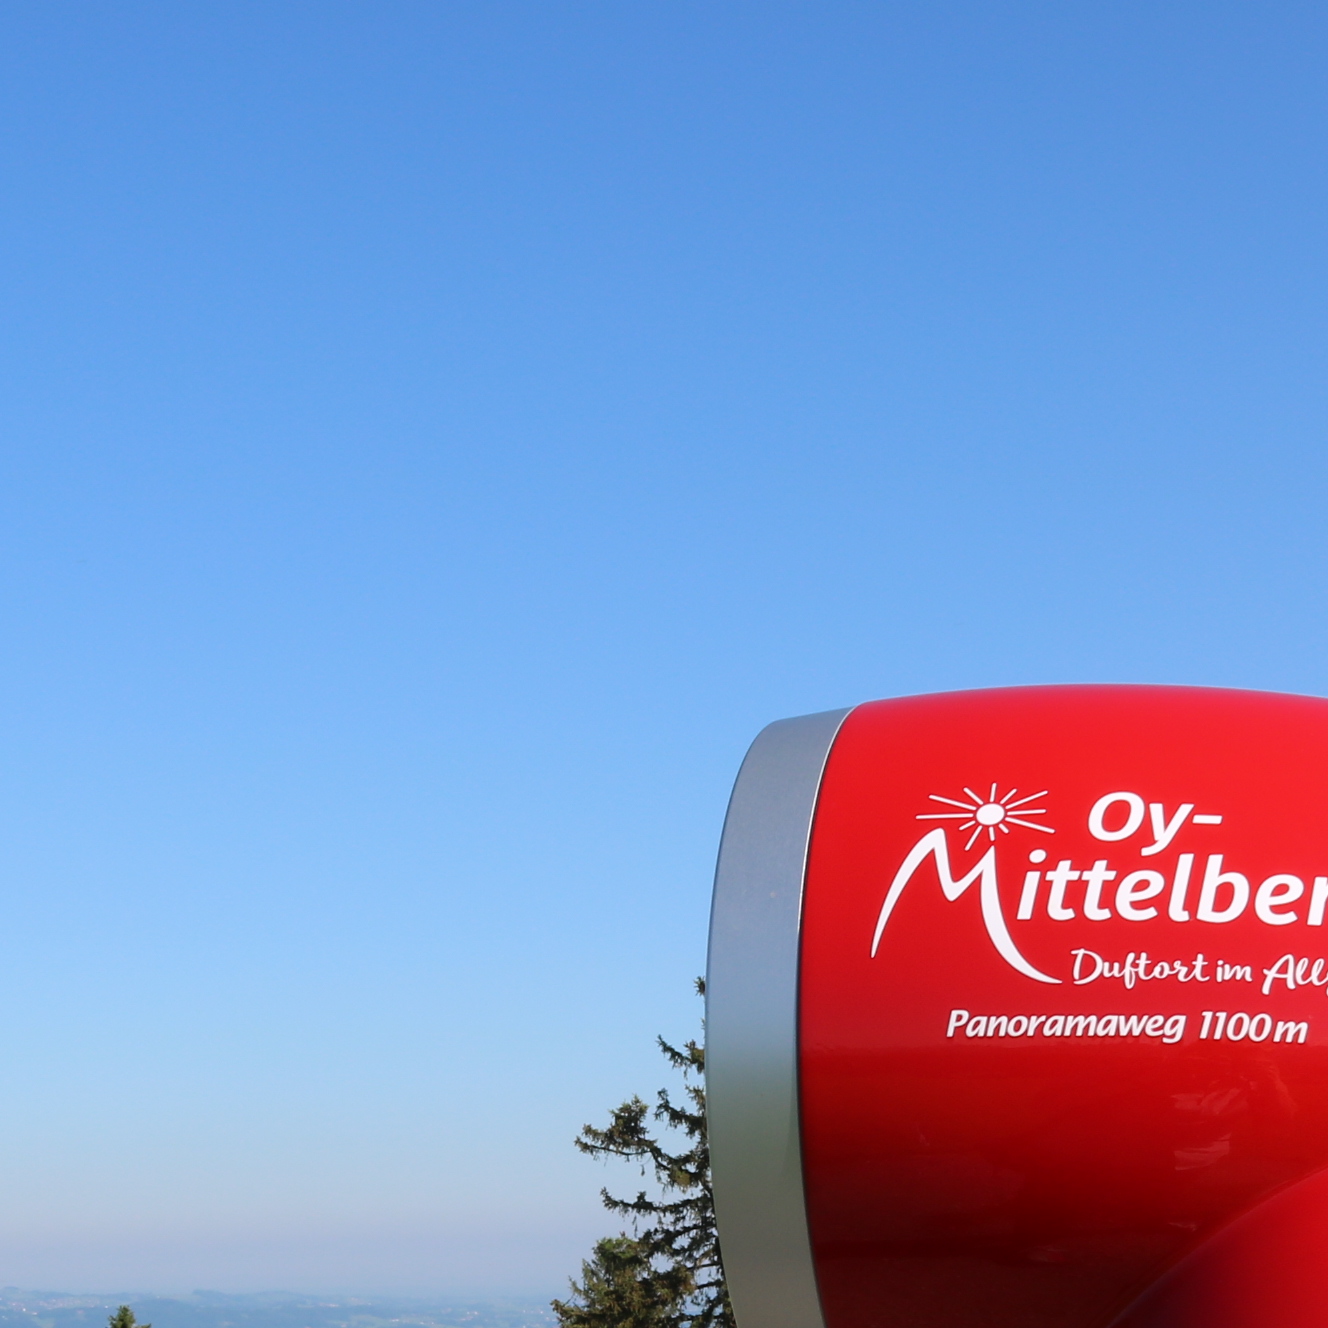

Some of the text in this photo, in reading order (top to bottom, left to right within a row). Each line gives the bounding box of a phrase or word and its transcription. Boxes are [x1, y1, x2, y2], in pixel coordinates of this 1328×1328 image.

[1088, 791, 1223, 857] Oy-
[1070, 948, 1210, 990] Duftort
[1216, 959, 1253, 985] im
[945, 1009, 1187, 1045] Panoramaweg
